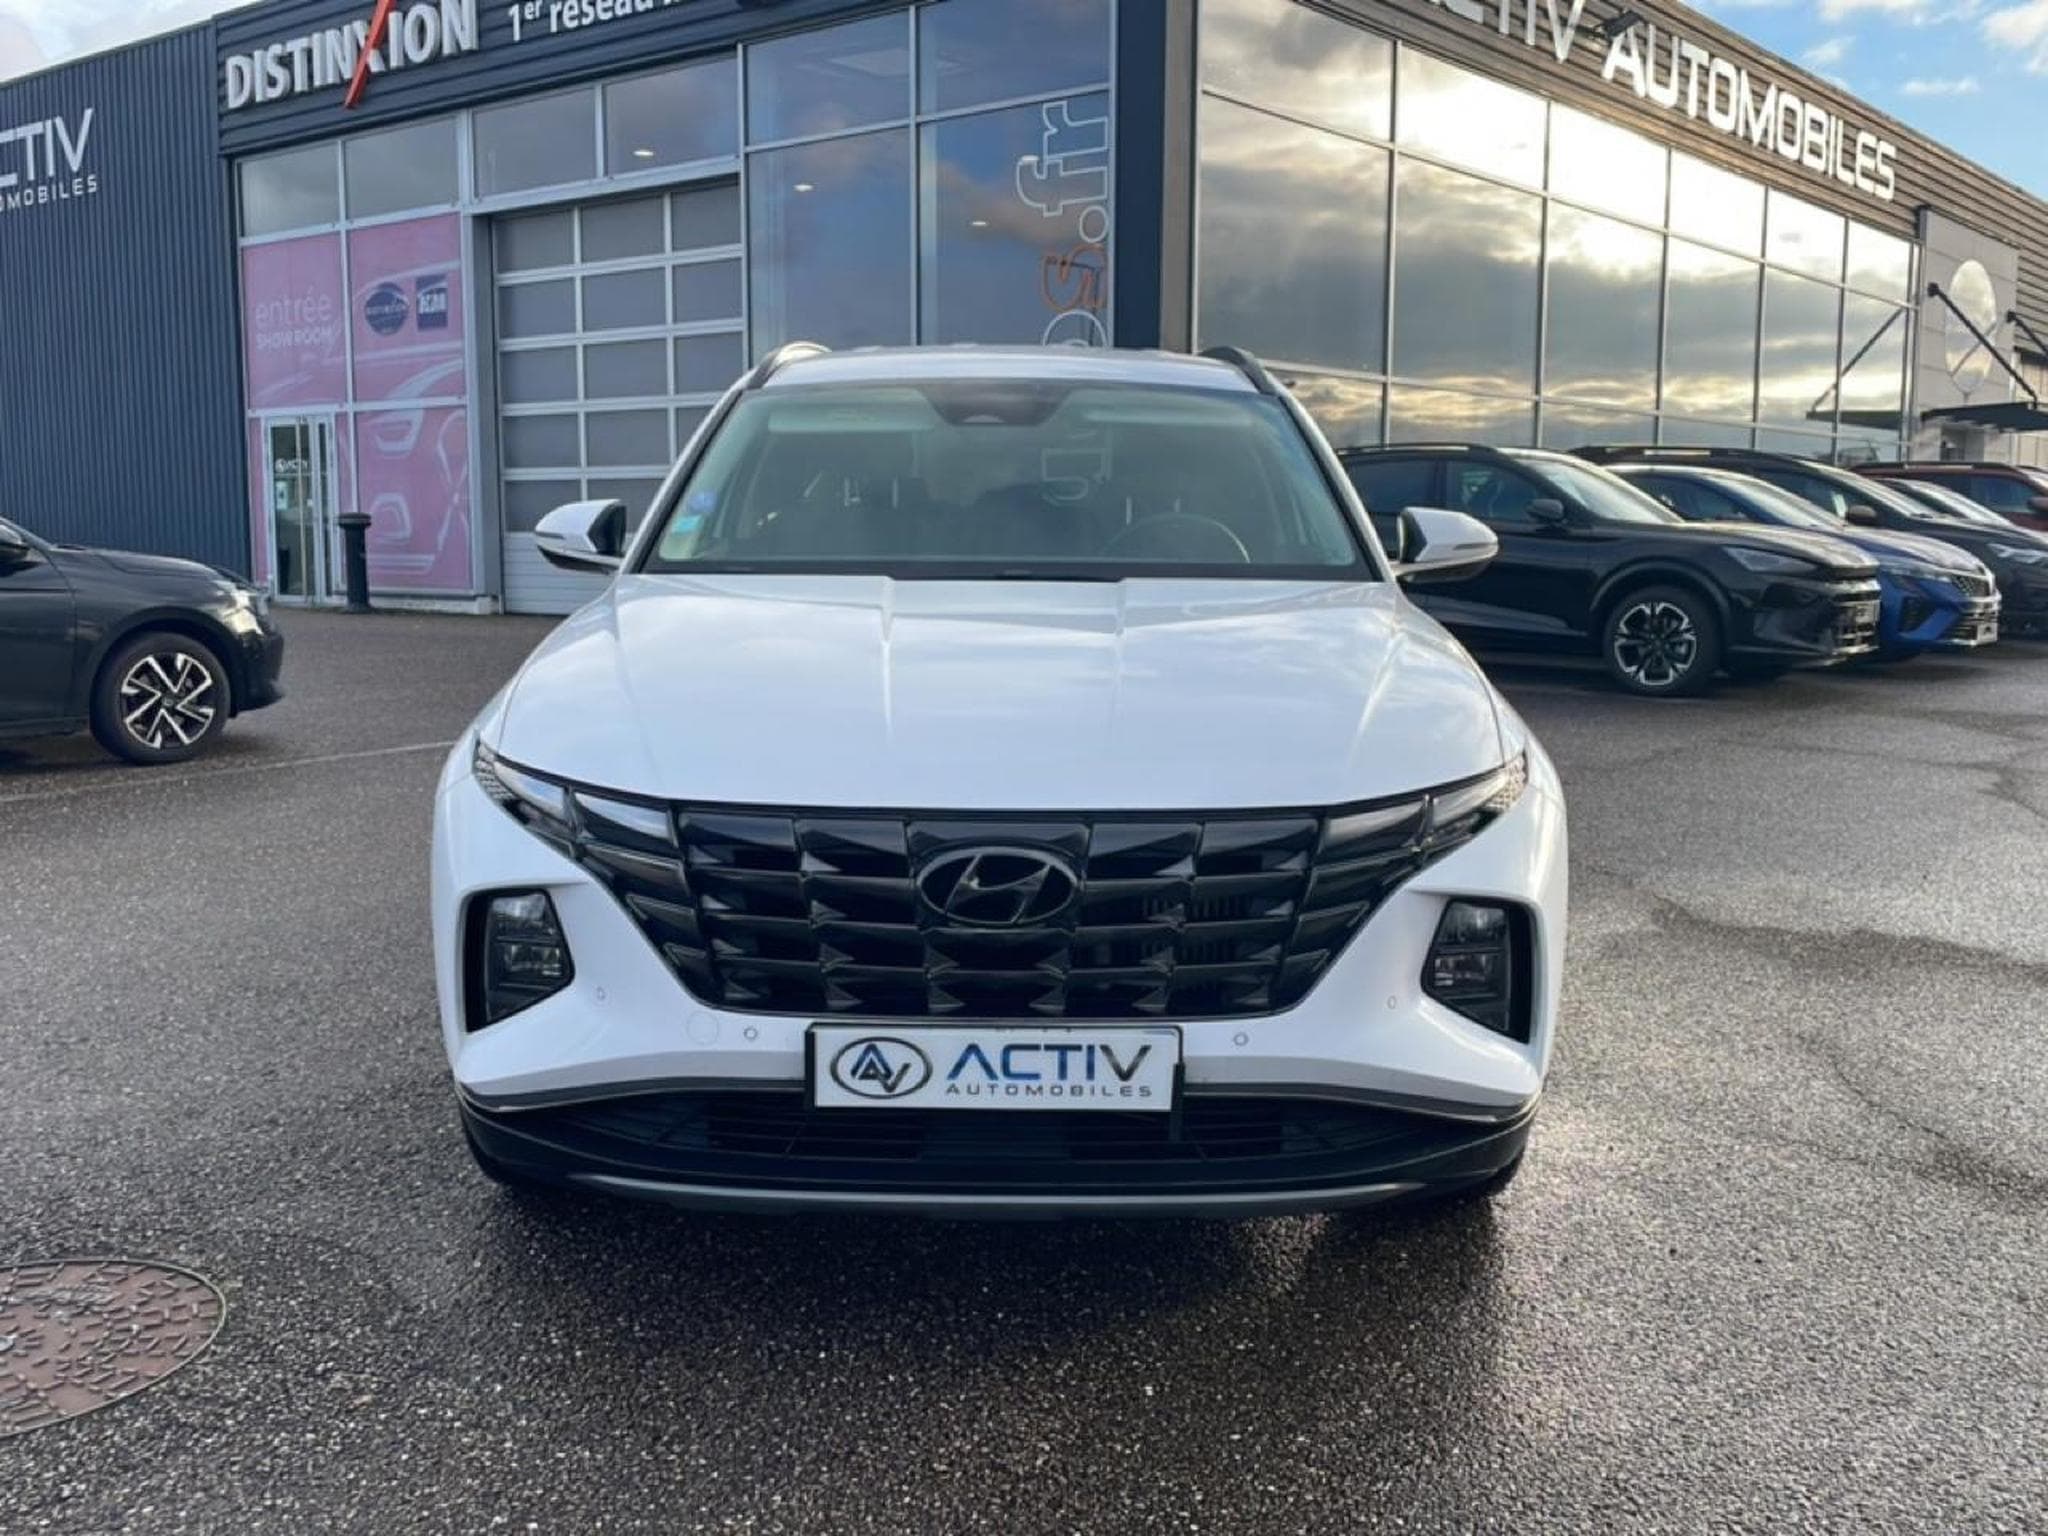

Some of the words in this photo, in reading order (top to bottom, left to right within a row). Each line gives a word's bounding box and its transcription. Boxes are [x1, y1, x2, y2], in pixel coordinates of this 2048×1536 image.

[225, 0, 480, 109] DISTINXION
[1602, 21, 1898, 201] AUTOMOBILES
[255, 286, 333, 329] entrée
[946, 1043, 1153, 1082] ACTIV
[945, 1083, 1154, 1097] AUTOMOBILES
